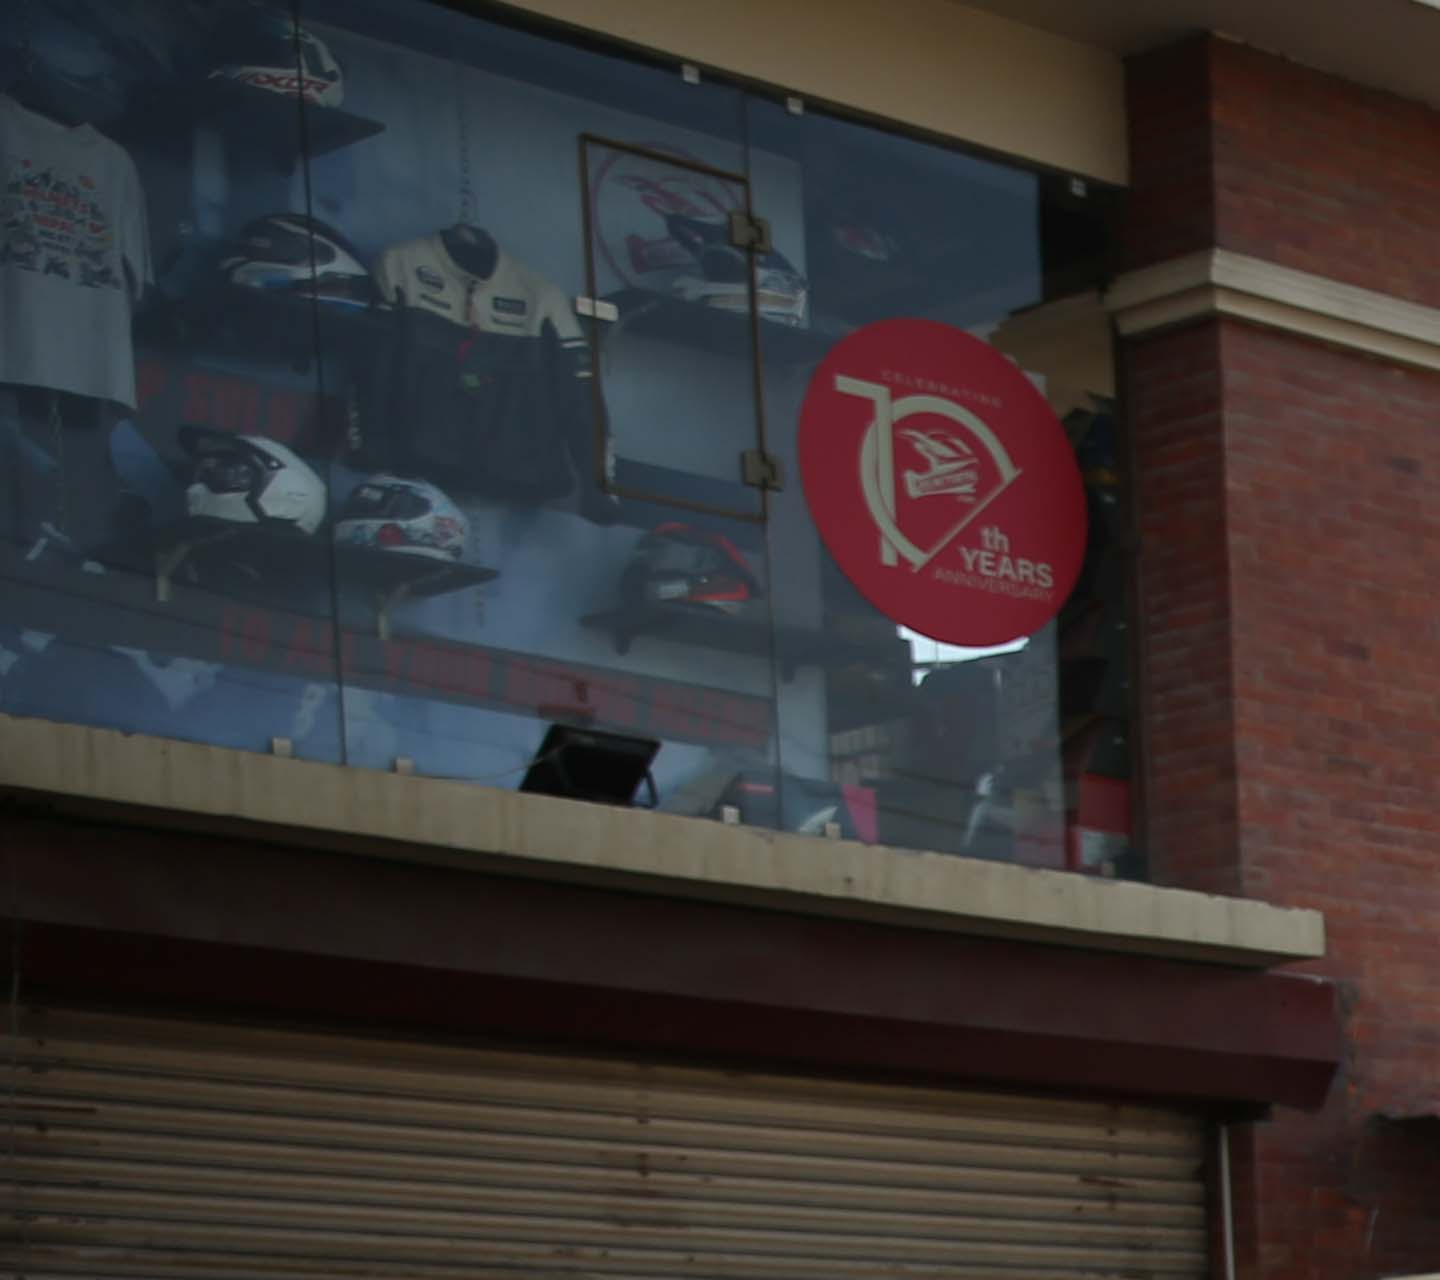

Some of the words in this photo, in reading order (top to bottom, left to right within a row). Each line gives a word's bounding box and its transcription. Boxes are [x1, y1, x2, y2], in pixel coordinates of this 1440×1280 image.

[980, 526, 1009, 554] th
[931, 566, 1053, 601] ANNIVERSARY
[958, 546, 1054, 588] YEARS
